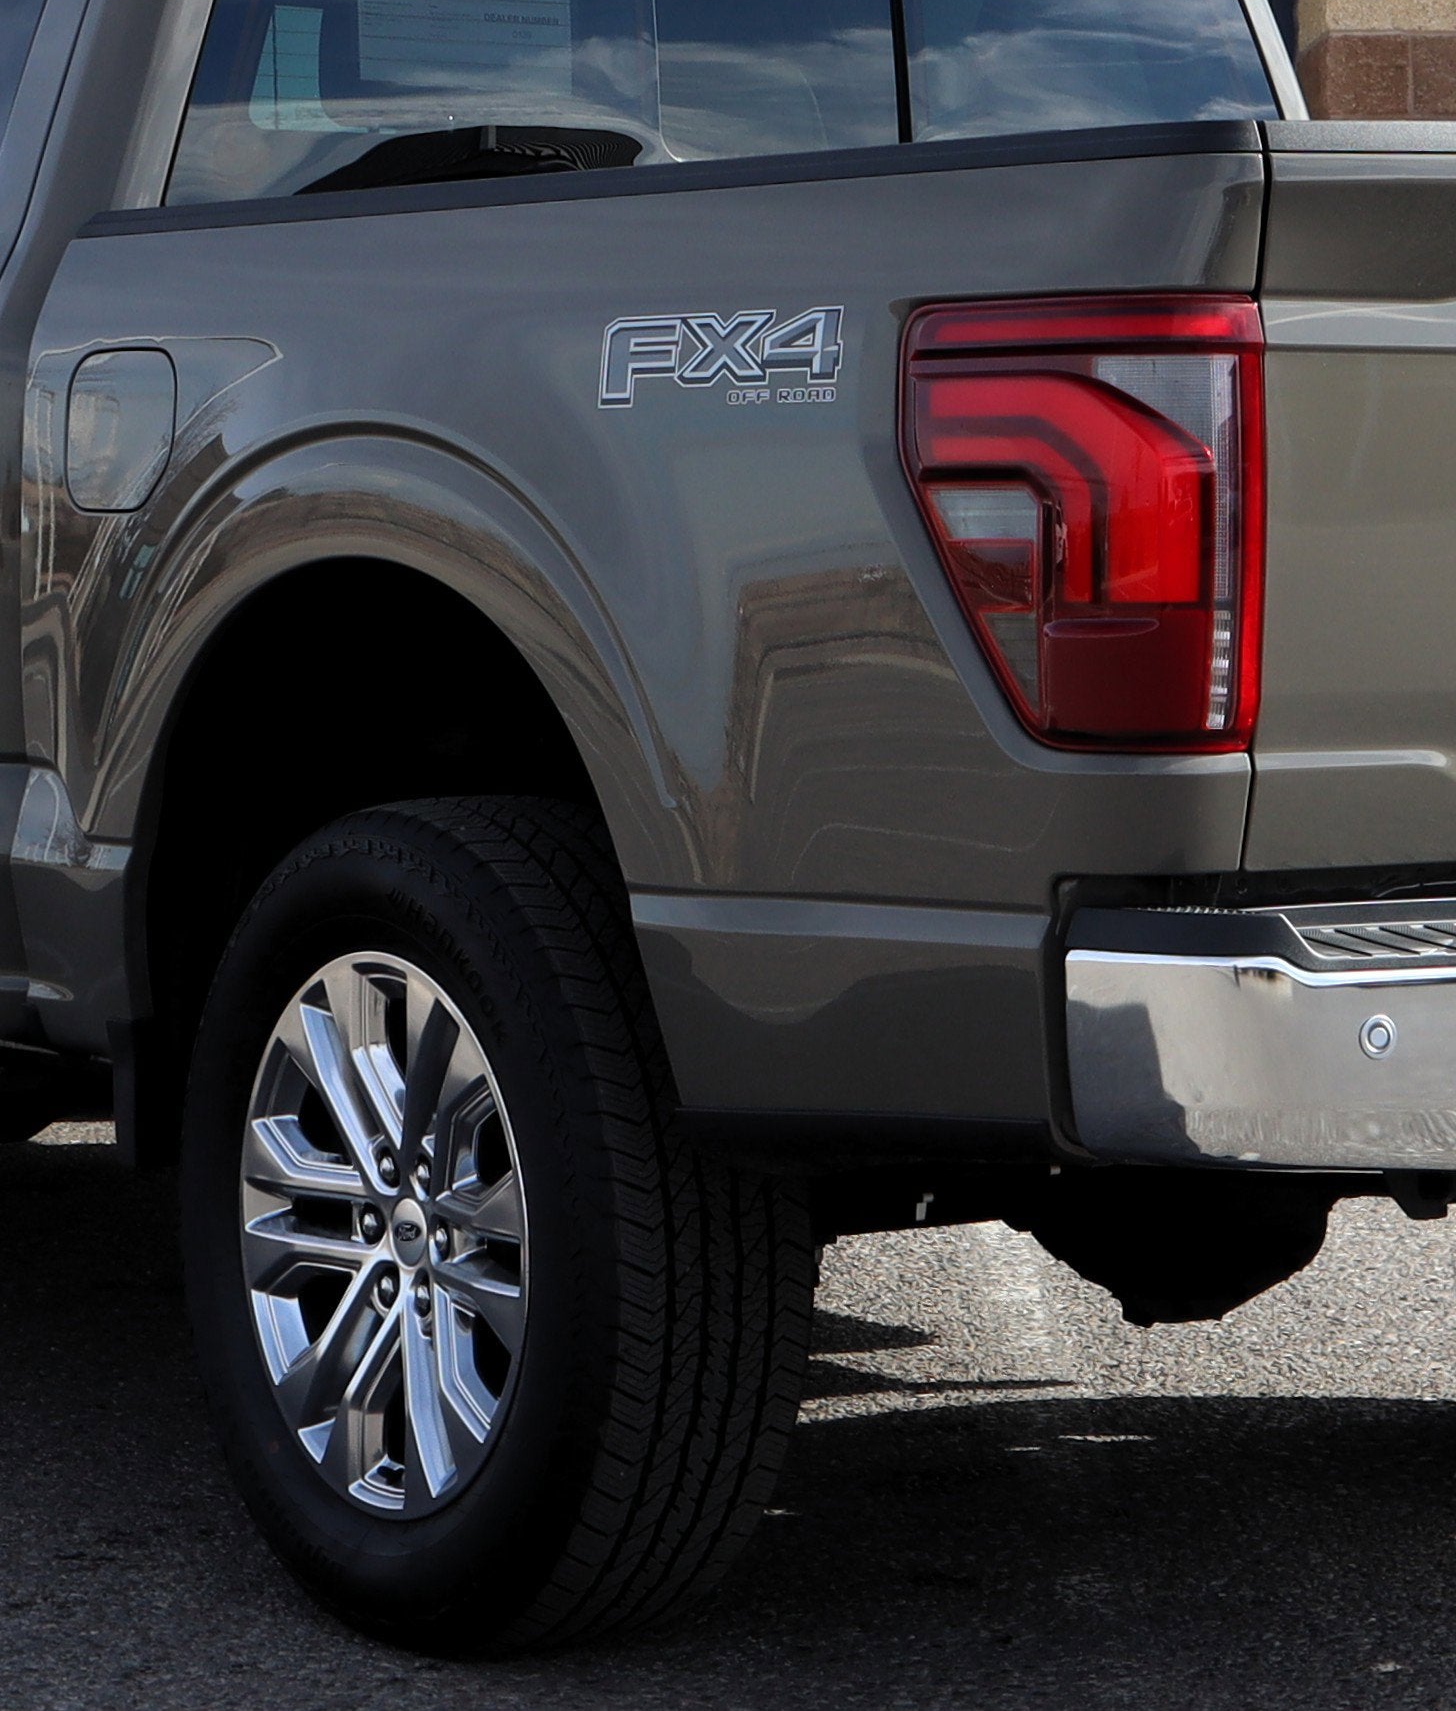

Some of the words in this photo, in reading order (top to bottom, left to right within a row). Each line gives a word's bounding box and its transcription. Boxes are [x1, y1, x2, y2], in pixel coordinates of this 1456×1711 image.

[483, 12, 520, 24] DEALER
[521, 15, 559, 26] NUMBER
[598, 306, 844, 409] FX4
[726, 388, 770, 405] OFF
[776, 386, 837, 403] ROAD
